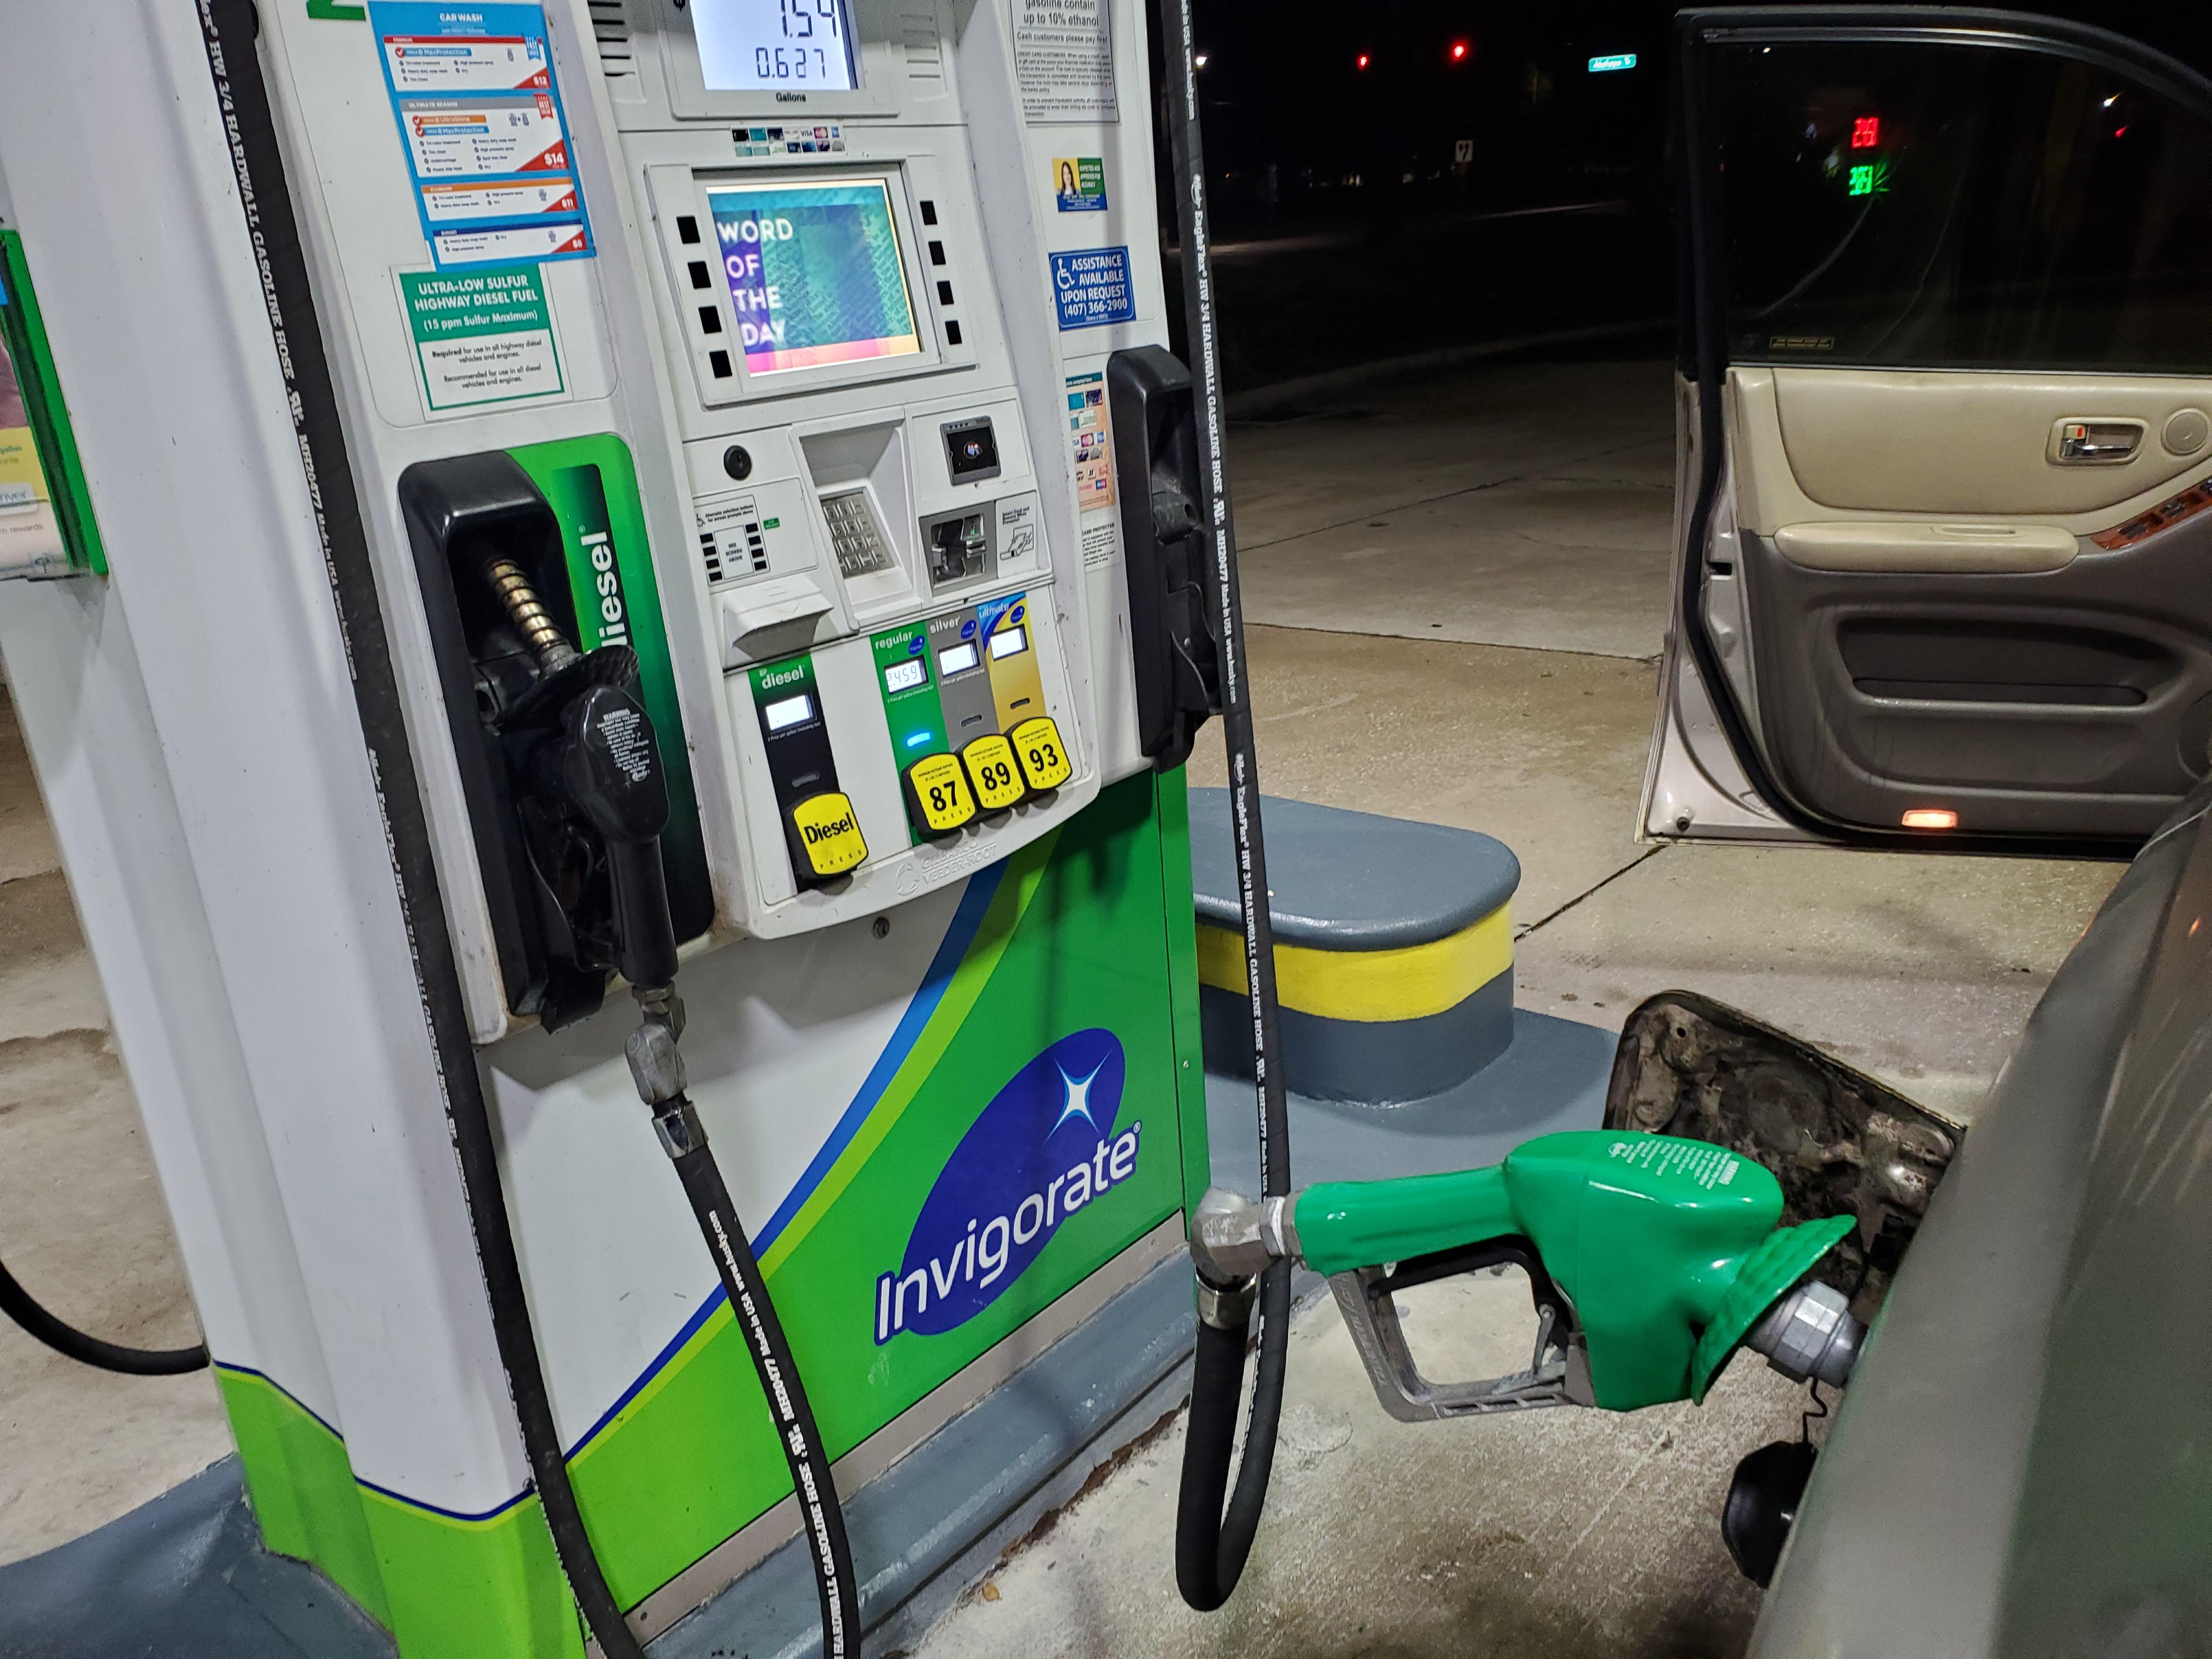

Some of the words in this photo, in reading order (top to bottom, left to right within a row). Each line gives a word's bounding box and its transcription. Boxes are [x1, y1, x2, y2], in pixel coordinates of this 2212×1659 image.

[439, 13, 456, 22] CAR
[457, 13, 483, 22] WASH
[1064, 0, 1095, 10] contain
[1024, 13, 1035, 26] up
[1037, 12, 1046, 24] to
[1049, 12, 1066, 25] 10%
[1069, 14, 1099, 26] ethanol
[1017, 31, 1032, 40] Cash
[1034, 32, 1064, 42] customers
[1066, 33, 1084, 44] please
[1086, 36, 1095, 44] pay
[1182, 26, 1190, 45] USA
[208, 40, 226, 78] HW
[755, 47, 825, 78] 0.627
[217, 79, 235, 112] 3/4
[1183, 48, 1195, 120] www.husky.com
[776, 92, 806, 102] Gallons
[223, 113, 262, 228] HARDWALL
[544, 152, 564, 166] $14
[718, 218, 793, 243] WORD
[726, 255, 760, 278] OF
[1072, 255, 1122, 272] ASSISTANCE
[251, 230, 282, 328] GASOLINE
[418, 279, 484, 295] ULTRA-LOW
[487, 274, 528, 288] SULFUR
[1079, 269, 1124, 286] AVAILABLE
[1199, 278, 1207, 301] HW
[414, 295, 471, 312] HIGHWAY
[473, 292, 510, 306] DIESEL
[512, 289, 538, 302] FUEL
[734, 286, 782, 312] THE
[1060, 288, 1086, 303] UPON
[1087, 284, 1125, 301] REQUEST
[424, 318, 439, 332] (15
[441, 317, 462, 330] ppm
[464, 313, 490, 327] Sulfur
[493, 309, 538, 324] Maximum)
[1064, 303, 1086, 319] (407)
[1088, 297, 1127, 314] 366-2900
[1200, 302, 1209, 321] 3/4
[741, 320, 786, 346] DAY
[274, 329, 294, 381] HOSE
[432, 348, 462, 358] Required
[464, 346, 472, 354] for
[500, 341, 524, 352] highway
[526, 338, 542, 347] diesel
[459, 354, 482, 364] vehicles
[496, 351, 521, 360] engines.
[1201, 323, 1215, 394] HARDWALL
[444, 371, 487, 382] Recommended
[525, 363, 541, 371] diesel
[462, 380, 485, 390] vehicles
[499, 375, 523, 386] engines.
[1206, 396, 1220, 459] GASOLINE
[297, 432, 323, 510] MH20477
[1211, 460, 1222, 493] HOSE
[10, 524, 43, 533] rewards
[1214, 528, 1229, 582] MH20477
[326, 561, 338, 586] USA
[929, 615, 960, 634] silver
[1222, 618, 1231, 636] USA
[874, 631, 913, 651] regular
[761, 664, 804, 690] diesel
[1223, 637, 1238, 704] www.husky.com
[1029, 743, 1058, 772] 93
[981, 761, 1011, 791] 89
[1035, 767, 1068, 785] PRESS
[929, 780, 957, 812] 87
[985, 786, 1021, 804] PRESS
[934, 806, 971, 825] PRESS
[804, 812, 854, 845] Diesel
[820, 849, 862, 869] PRESS
[922, 845, 997, 885] VEEDER-ROOT
[1240, 849, 1250, 870] HW
[1242, 872, 1251, 889] 3/4
[1244, 890, 1256, 956] HARDWALL
[1248, 958, 1261, 1018] GASOLINE
[1252, 1019, 1264, 1051] HOSE
[879, 1139, 1136, 1341] Invigorate
[740, 1291, 757, 1316] USA
[763, 1356, 795, 1421] MH20477
[798, 1460, 819, 1503] HOSE
[809, 1502, 836, 1576] GASOLINE
[822, 1576, 847, 1655] HARDWALL
